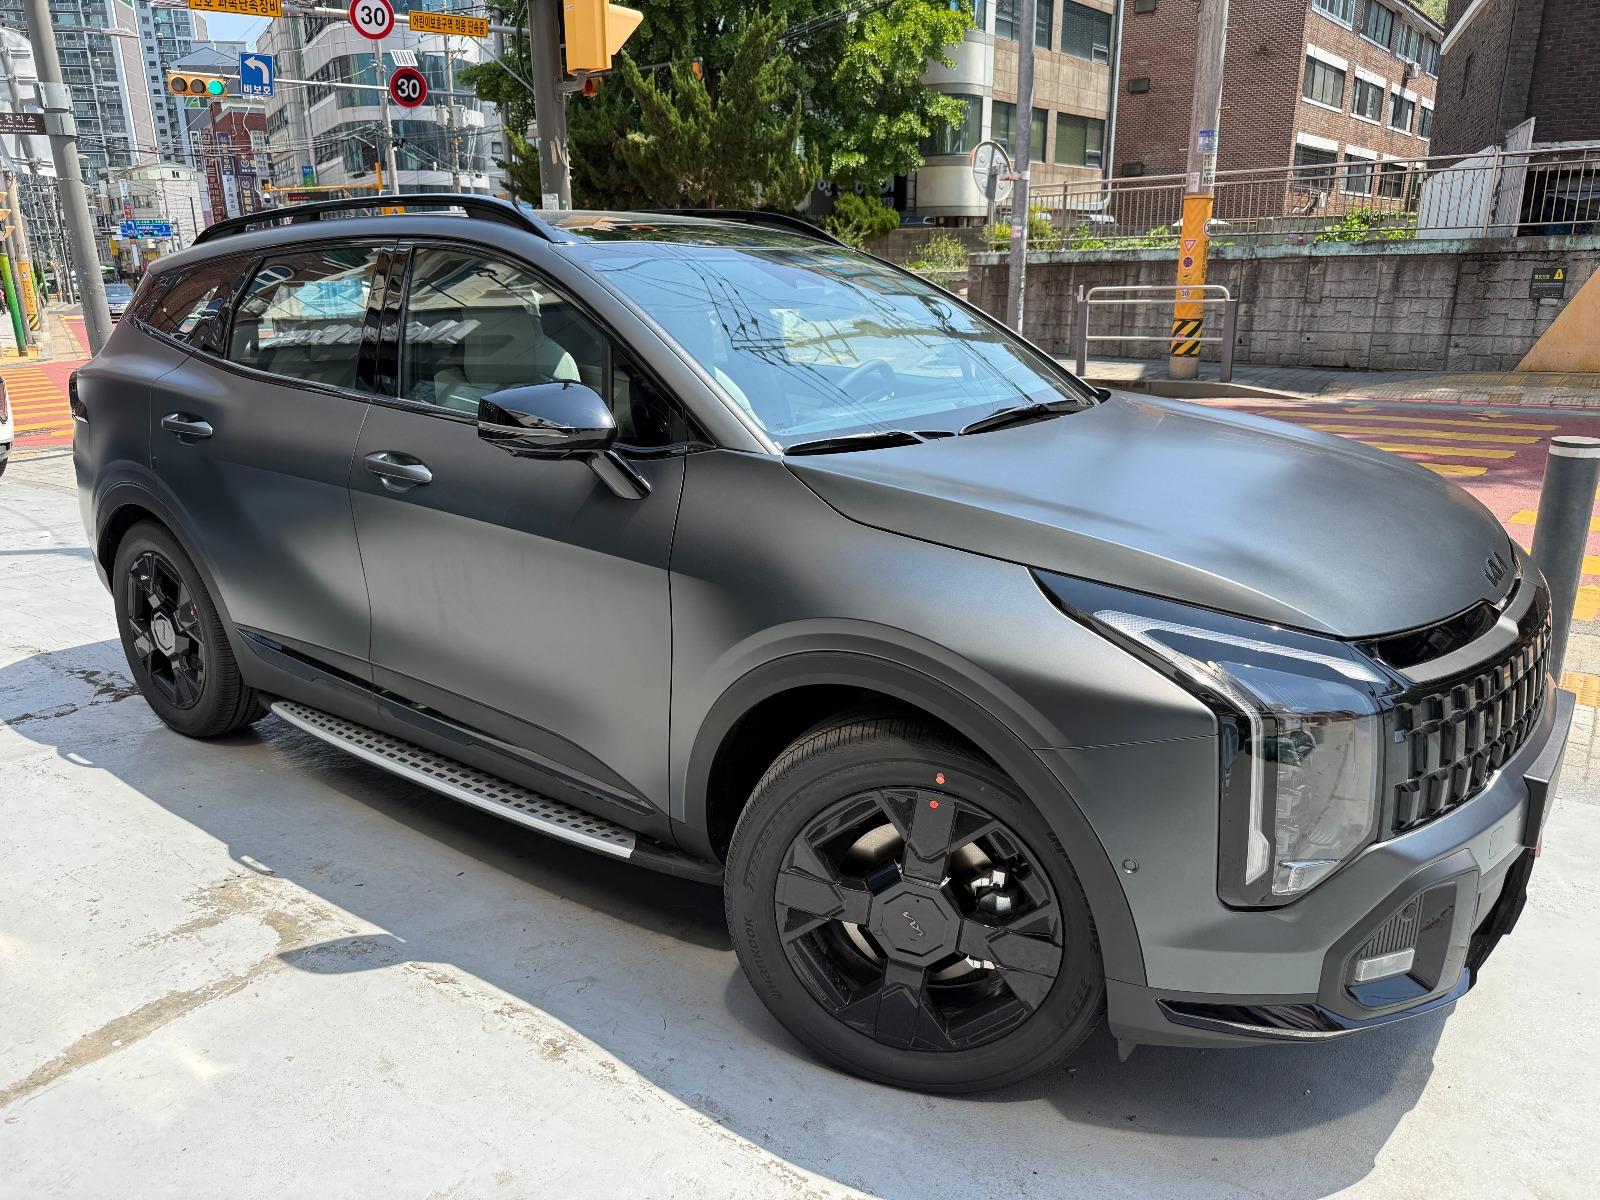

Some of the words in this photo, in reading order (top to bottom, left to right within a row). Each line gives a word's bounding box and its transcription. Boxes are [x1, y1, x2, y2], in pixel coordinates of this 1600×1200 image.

[218, 0, 279, 14] 과속단속장비
[360, 5, 386, 27] 30
[412, 14, 453, 31] 어린이보호구역
[455, 19, 467, 33] 적용
[468, 20, 485, 35] 단속중
[243, 84, 272, 96] 비보호
[397, 78, 420, 99] 30
[0, 114, 36, 124] 건지소
